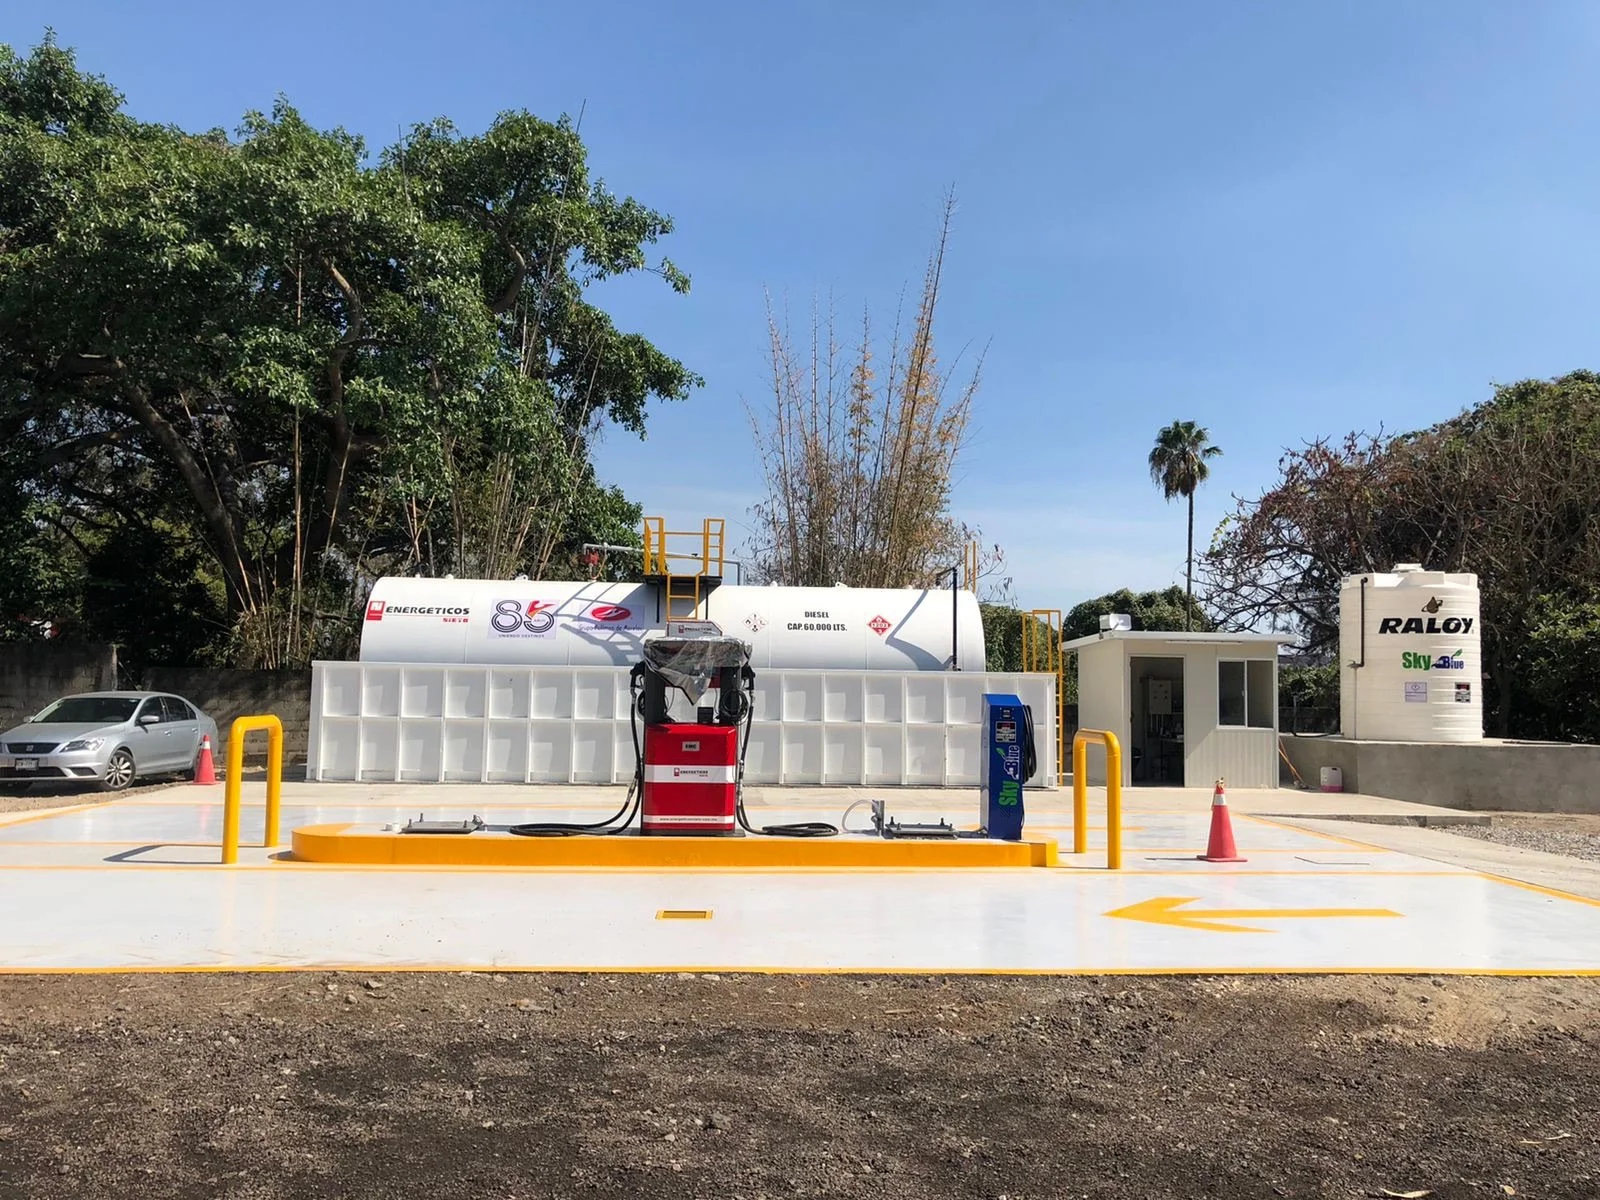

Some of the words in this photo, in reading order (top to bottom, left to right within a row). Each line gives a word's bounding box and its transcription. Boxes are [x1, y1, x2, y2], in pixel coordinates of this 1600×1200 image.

[386, 606, 470, 615] ENERGETICOS
[491, 600, 556, 633] 85
[833, 623, 847, 631] LTS.
[1379, 617, 1473, 634] RALOY
[1402, 652, 1431, 670] Sky
[998, 781, 1020, 805] Sky
